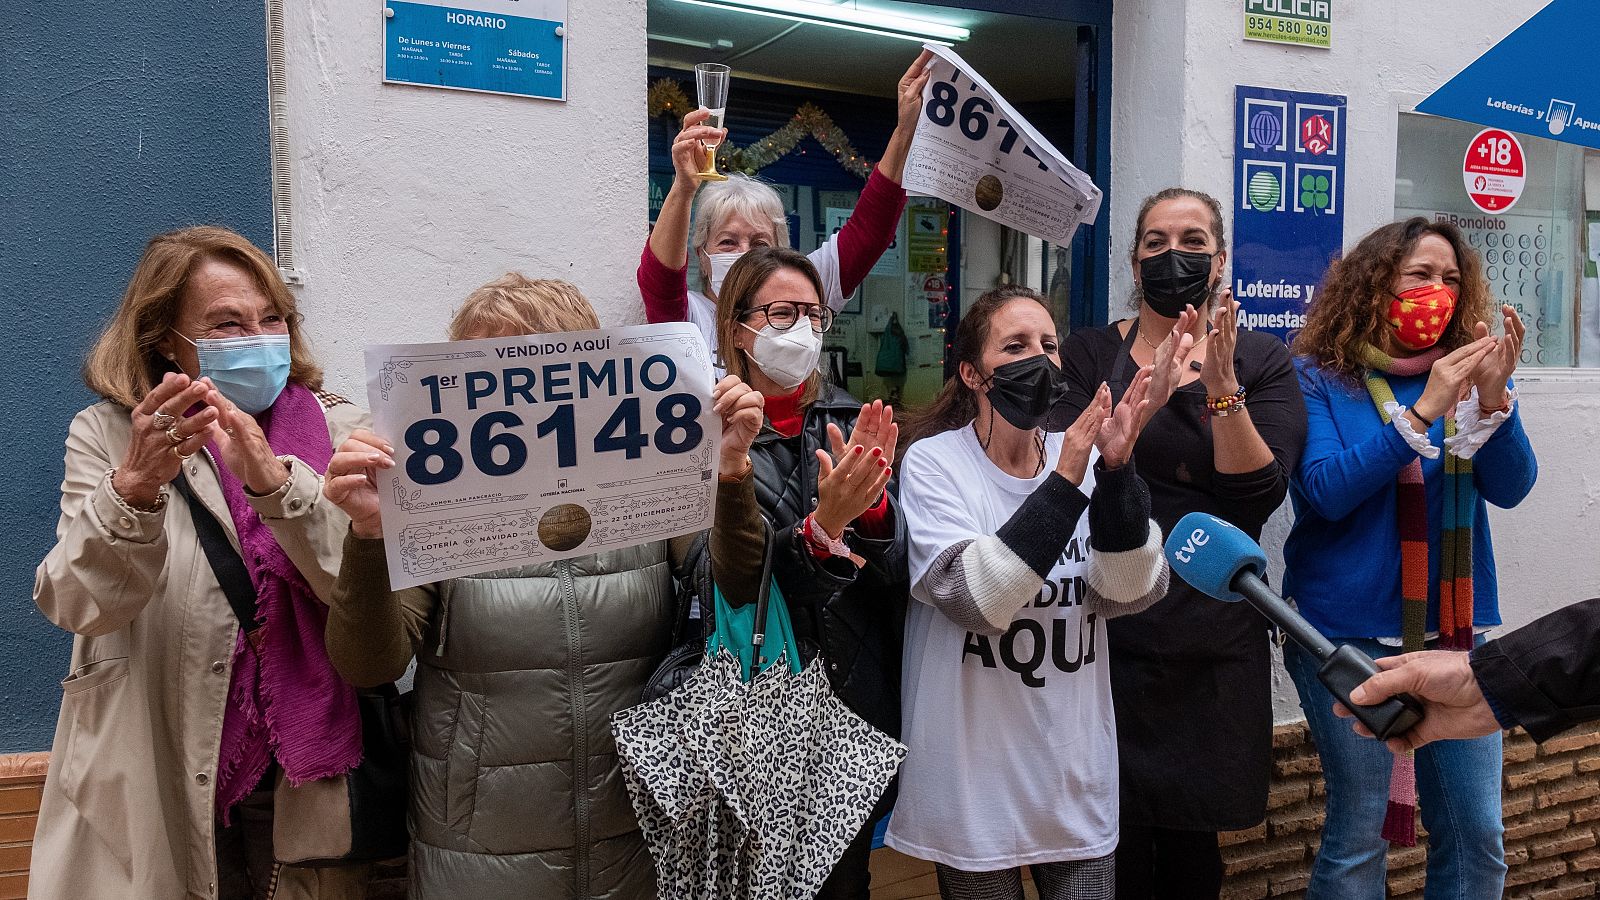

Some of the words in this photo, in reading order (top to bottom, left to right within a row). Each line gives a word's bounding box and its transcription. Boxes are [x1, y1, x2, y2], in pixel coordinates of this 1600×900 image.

[446, 12, 506, 30] HORARIO
[1249, 17, 1272, 31] 954
[1278, 20, 1300, 34] 580
[1306, 24, 1328, 37] 949
[398, 36, 409, 44] De
[411, 37, 434, 47] Lunes
[441, 41, 471, 51] Viernes
[1247, 31, 1329, 45] www.hercules-seguridad.com
[508, 48, 540, 60] Sábados
[1486, 96, 1534, 116] Loterías
[1536, 110, 1545, 120] y
[1477, 137, 1511, 165] +18
[915, 162, 937, 172] LOTERÍA
[947, 173, 967, 185] NAVIDAD
[1025, 206, 1050, 218] DICIEMBRE
[1450, 214, 1506, 230] Bonoloto
[1237, 278, 1301, 299] Loterías
[1305, 285, 1315, 304] y
[1236, 309, 1308, 331] Apuestas
[495, 342, 568, 359] VENDIDO
[572, 335, 610, 352] AQUÍ
[464, 354, 677, 410] PREMIO
[404, 392, 704, 486] 86148
[469, 492, 502, 501] PANCRACIO
[540, 489, 561, 498] LOTERÍA
[561, 487, 586, 496] NACIONAL
[635, 507, 676, 519] DICIEMBRE
[677, 503, 694, 511] 2021
[421, 540, 458, 551] LOTERÍA
[479, 532, 518, 543] NAVIDAD
[1174, 528, 1210, 564] tve
